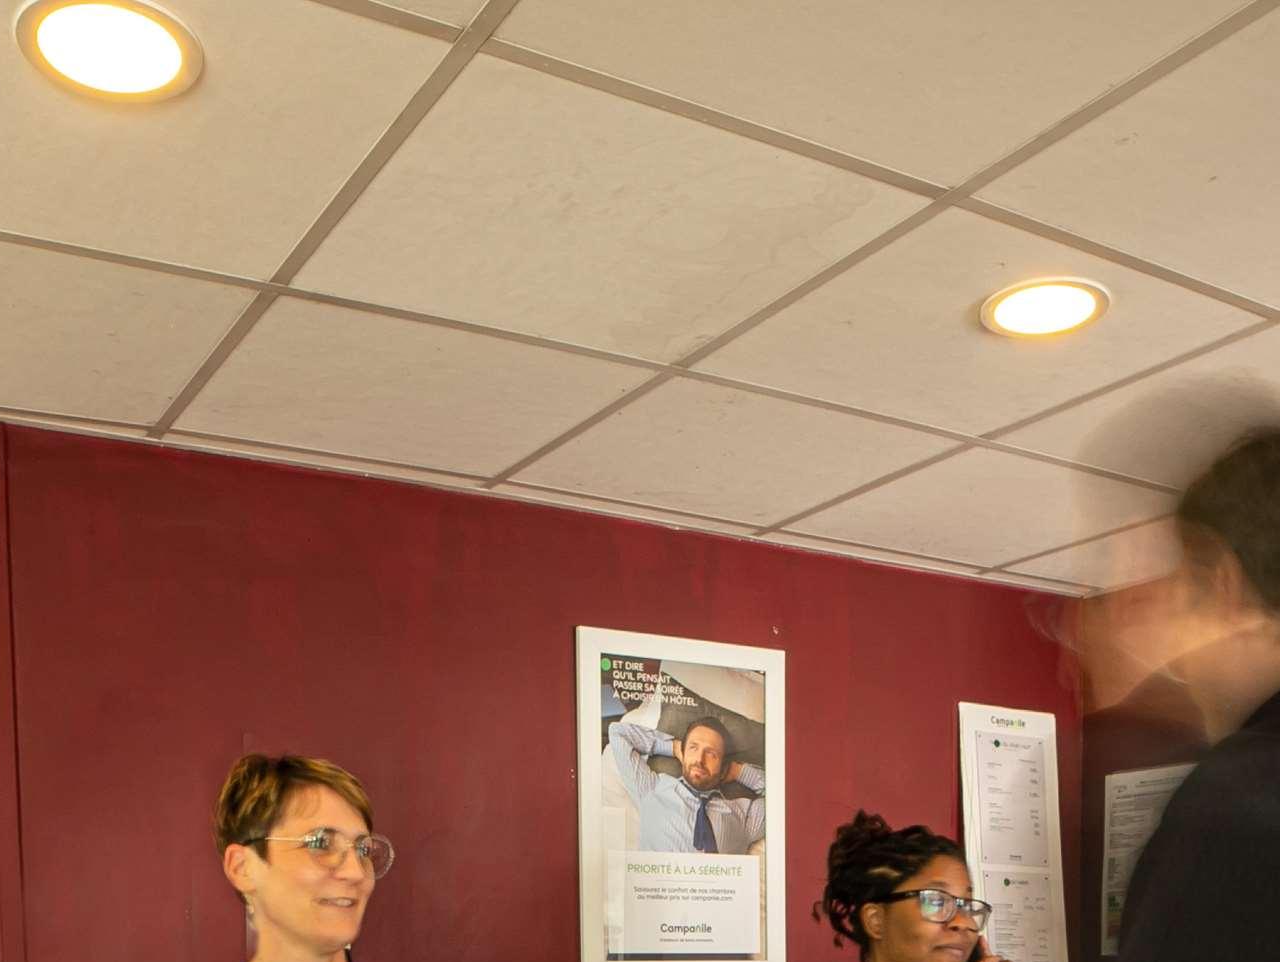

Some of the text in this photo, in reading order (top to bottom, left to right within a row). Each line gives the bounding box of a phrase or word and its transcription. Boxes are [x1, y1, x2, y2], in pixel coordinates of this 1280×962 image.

[613, 660, 645, 672] ET DIRE
[613, 671, 672, 684] QU'IL PENSAIT
[613, 680, 643, 691] PASSER
[644, 684, 655, 692] SA
[627, 862, 672, 874] PRIORITÉ
[684, 865, 697, 874] LA
[699, 863, 744, 877] SÉRÉNITÉ
[660, 922, 713, 936] Campanile
